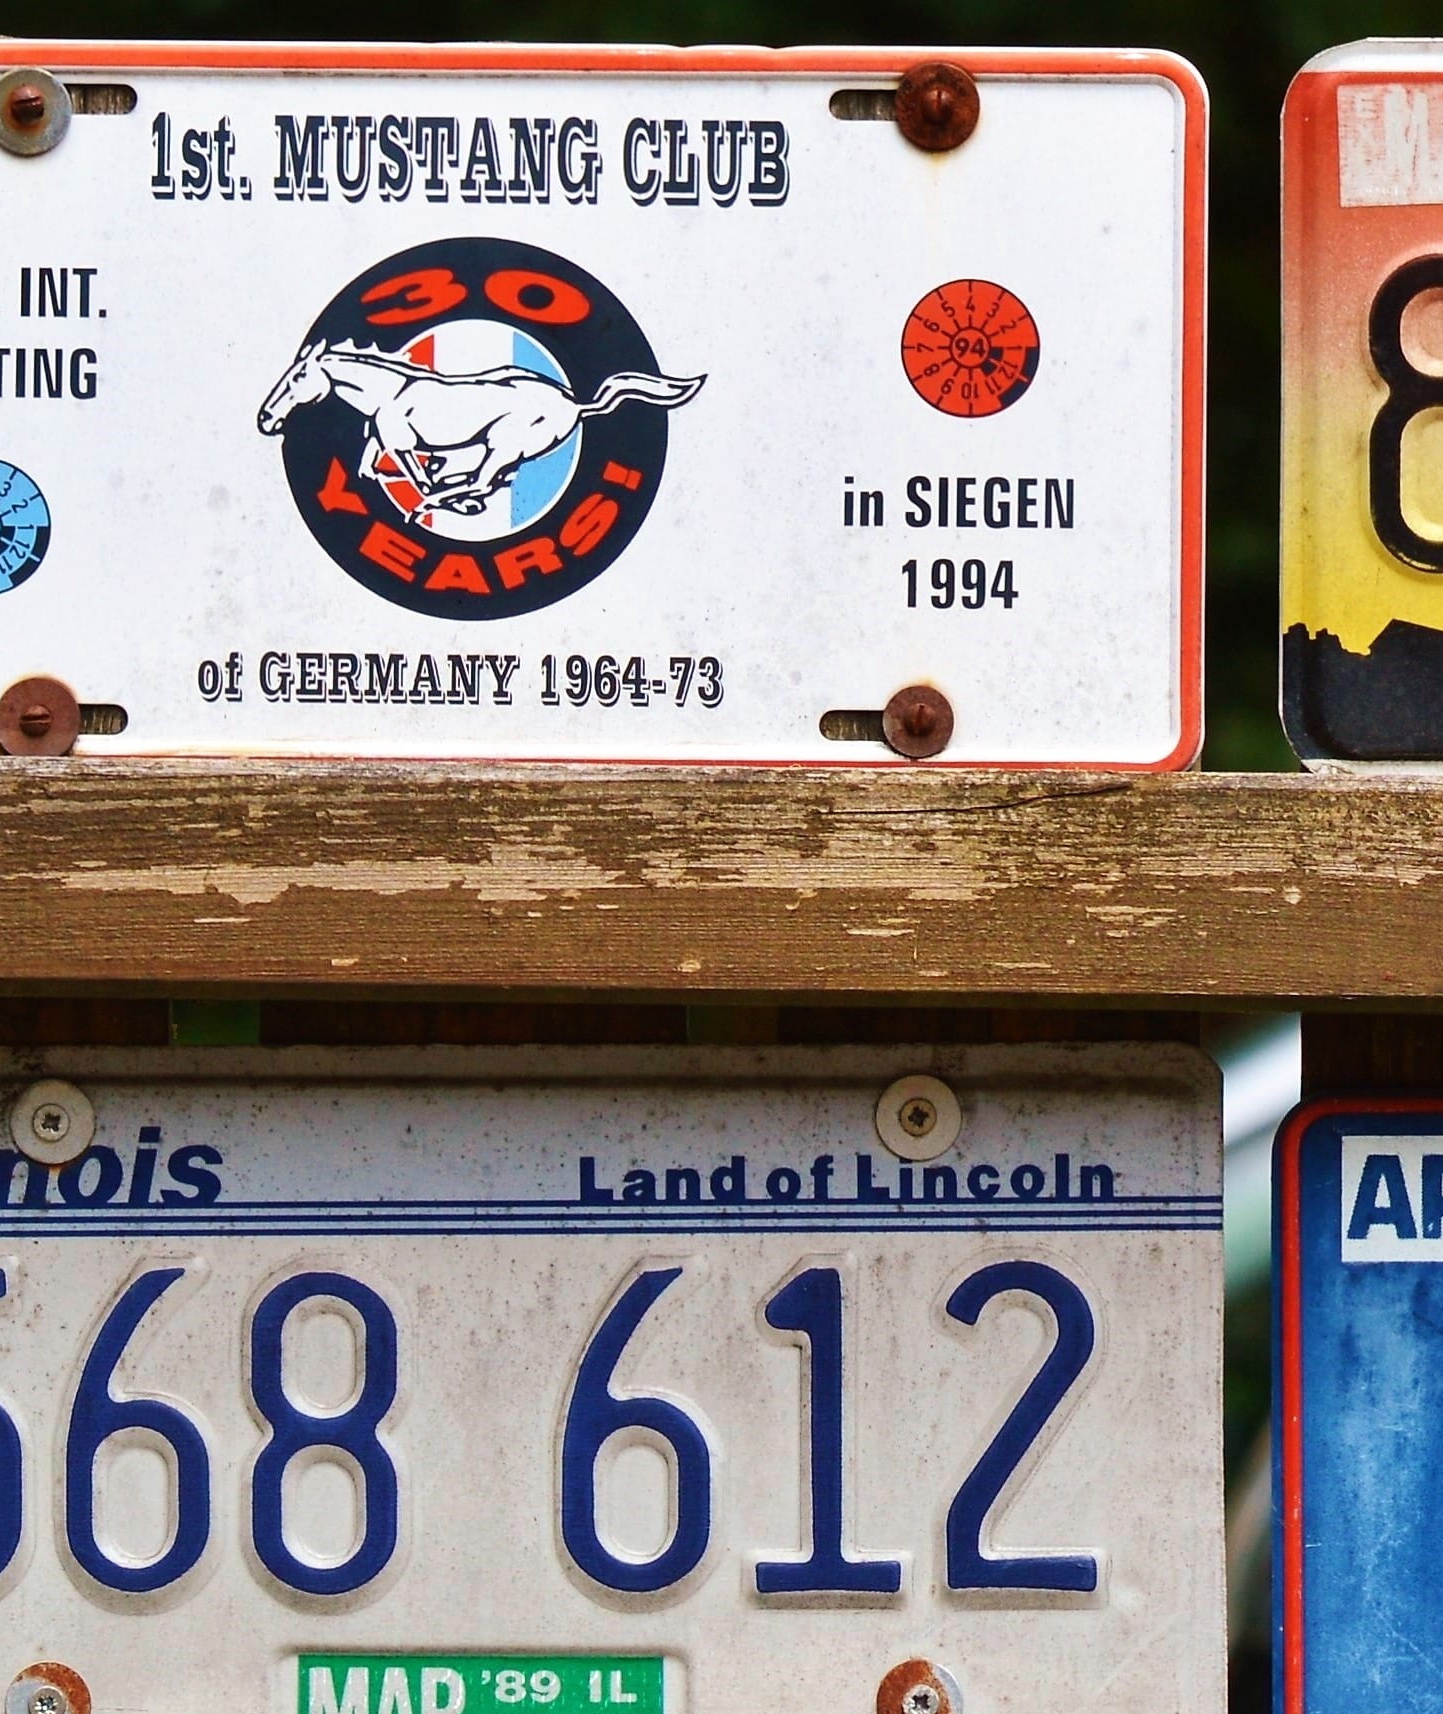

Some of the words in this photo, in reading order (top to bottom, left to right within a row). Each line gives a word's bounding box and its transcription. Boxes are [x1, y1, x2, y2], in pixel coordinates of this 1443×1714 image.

[152, 112, 251, 200] 1st.
[274, 115, 602, 204] MUSTANG
[624, 118, 789, 207] CLUB
[21, 268, 106, 317] INT.
[362, 269, 590, 325] 30
[941, 301, 955, 317] 5
[965, 296, 975, 312] 4
[987, 303, 1000, 318] 3
[923, 319, 940, 333] 6
[999, 320, 1016, 334] 2
[917, 343, 934, 353] 7
[955, 338, 985, 358] 94
[923, 363, 940, 377] 8
[998, 360, 1018, 379] 12
[941, 378, 954, 394] 9
[961, 382, 979, 399] 10
[985, 377, 1002, 394] 11
[12, 499, 29, 513] 2
[844, 477, 883, 526] in
[906, 476, 1073, 528] SIEGEN
[317, 457, 643, 594] YEARS!
[9, 540, 30, 559] 12
[902, 559, 1018, 609] 1994
[198, 652, 242, 702] of
[260, 652, 520, 705] GERMANY
[541, 655, 723, 708] 1964-73
[579, 1154, 747, 1199] Land
[768, 1154, 836, 1199] of
[854, 1151, 1116, 1198] Lincoln
[562, 1259, 1097, 1593] 612
[482, 1670, 560, 1703] '89
[590, 1670, 636, 1703] IL
